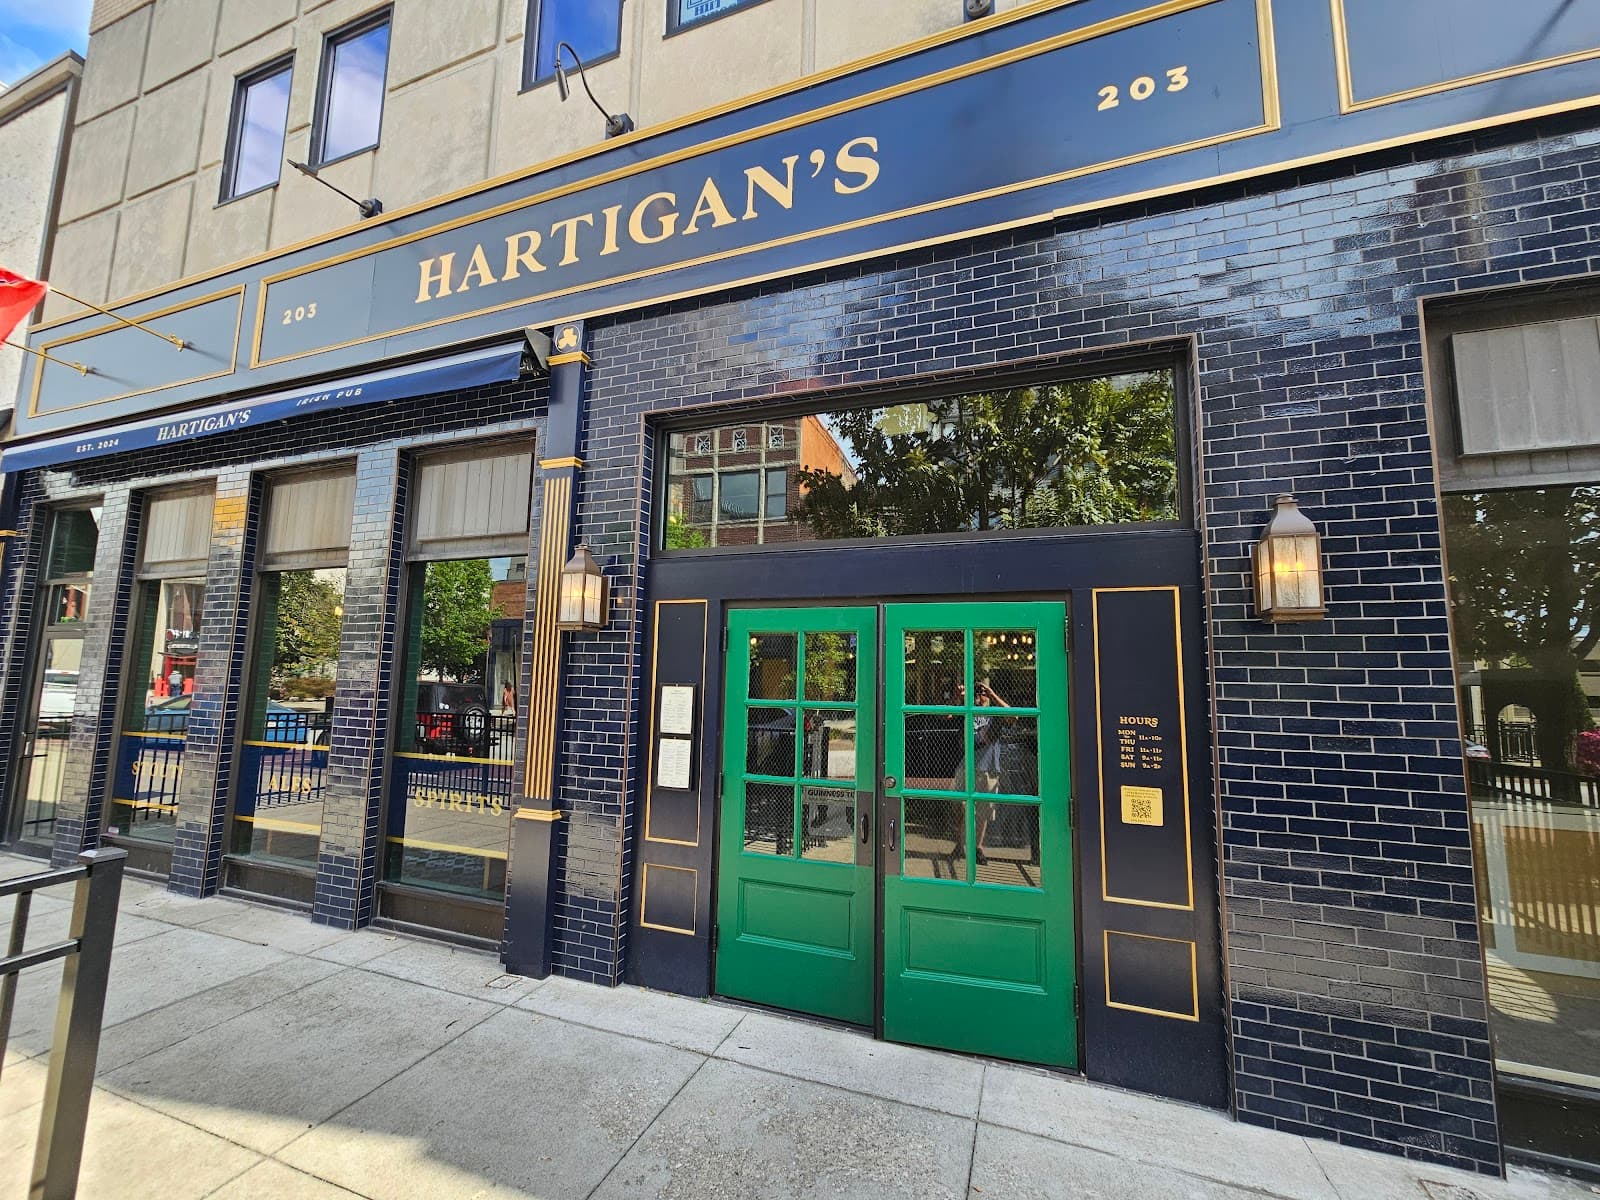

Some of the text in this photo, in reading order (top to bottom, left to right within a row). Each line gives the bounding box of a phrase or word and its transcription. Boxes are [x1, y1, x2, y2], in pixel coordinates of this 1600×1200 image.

[1097, 65, 1189, 112] 203
[415, 136, 880, 304] HARTIGAN'S
[282, 302, 317, 325] 203
[336, 388, 363, 399] PUB
[156, 409, 252, 442] HARTIGAN'S
[76, 438, 119, 453] EST. 2024
[1119, 716, 1159, 728] HOURS
[1119, 761, 1136, 769] SUN
[269, 774, 312, 793] ALES
[414, 789, 503, 817] SPIRITS
